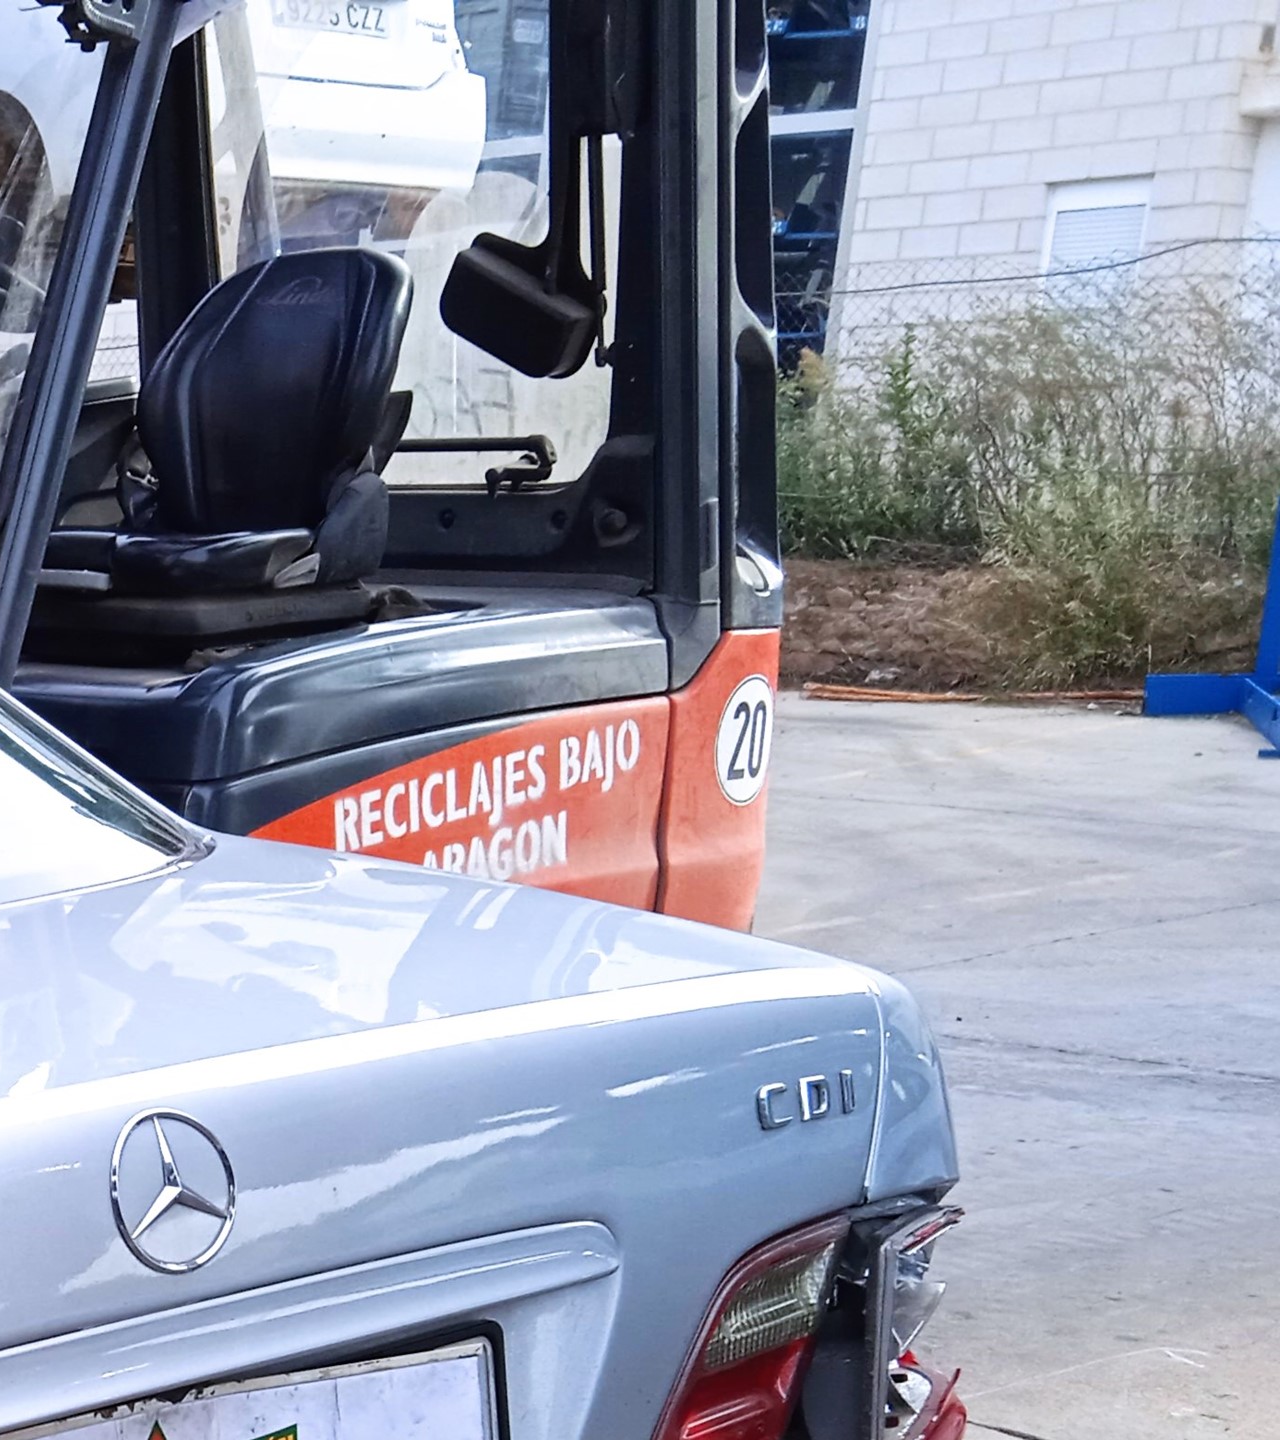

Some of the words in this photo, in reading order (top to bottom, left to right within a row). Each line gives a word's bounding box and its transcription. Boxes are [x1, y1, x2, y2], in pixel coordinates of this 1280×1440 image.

[347, 3, 385, 32] CZZ
[728, 701, 767, 781] 20
[333, 745, 546, 852] RECICLAJES
[559, 719, 640, 793] BAJO
[756, 1069, 856, 1130] CDI
